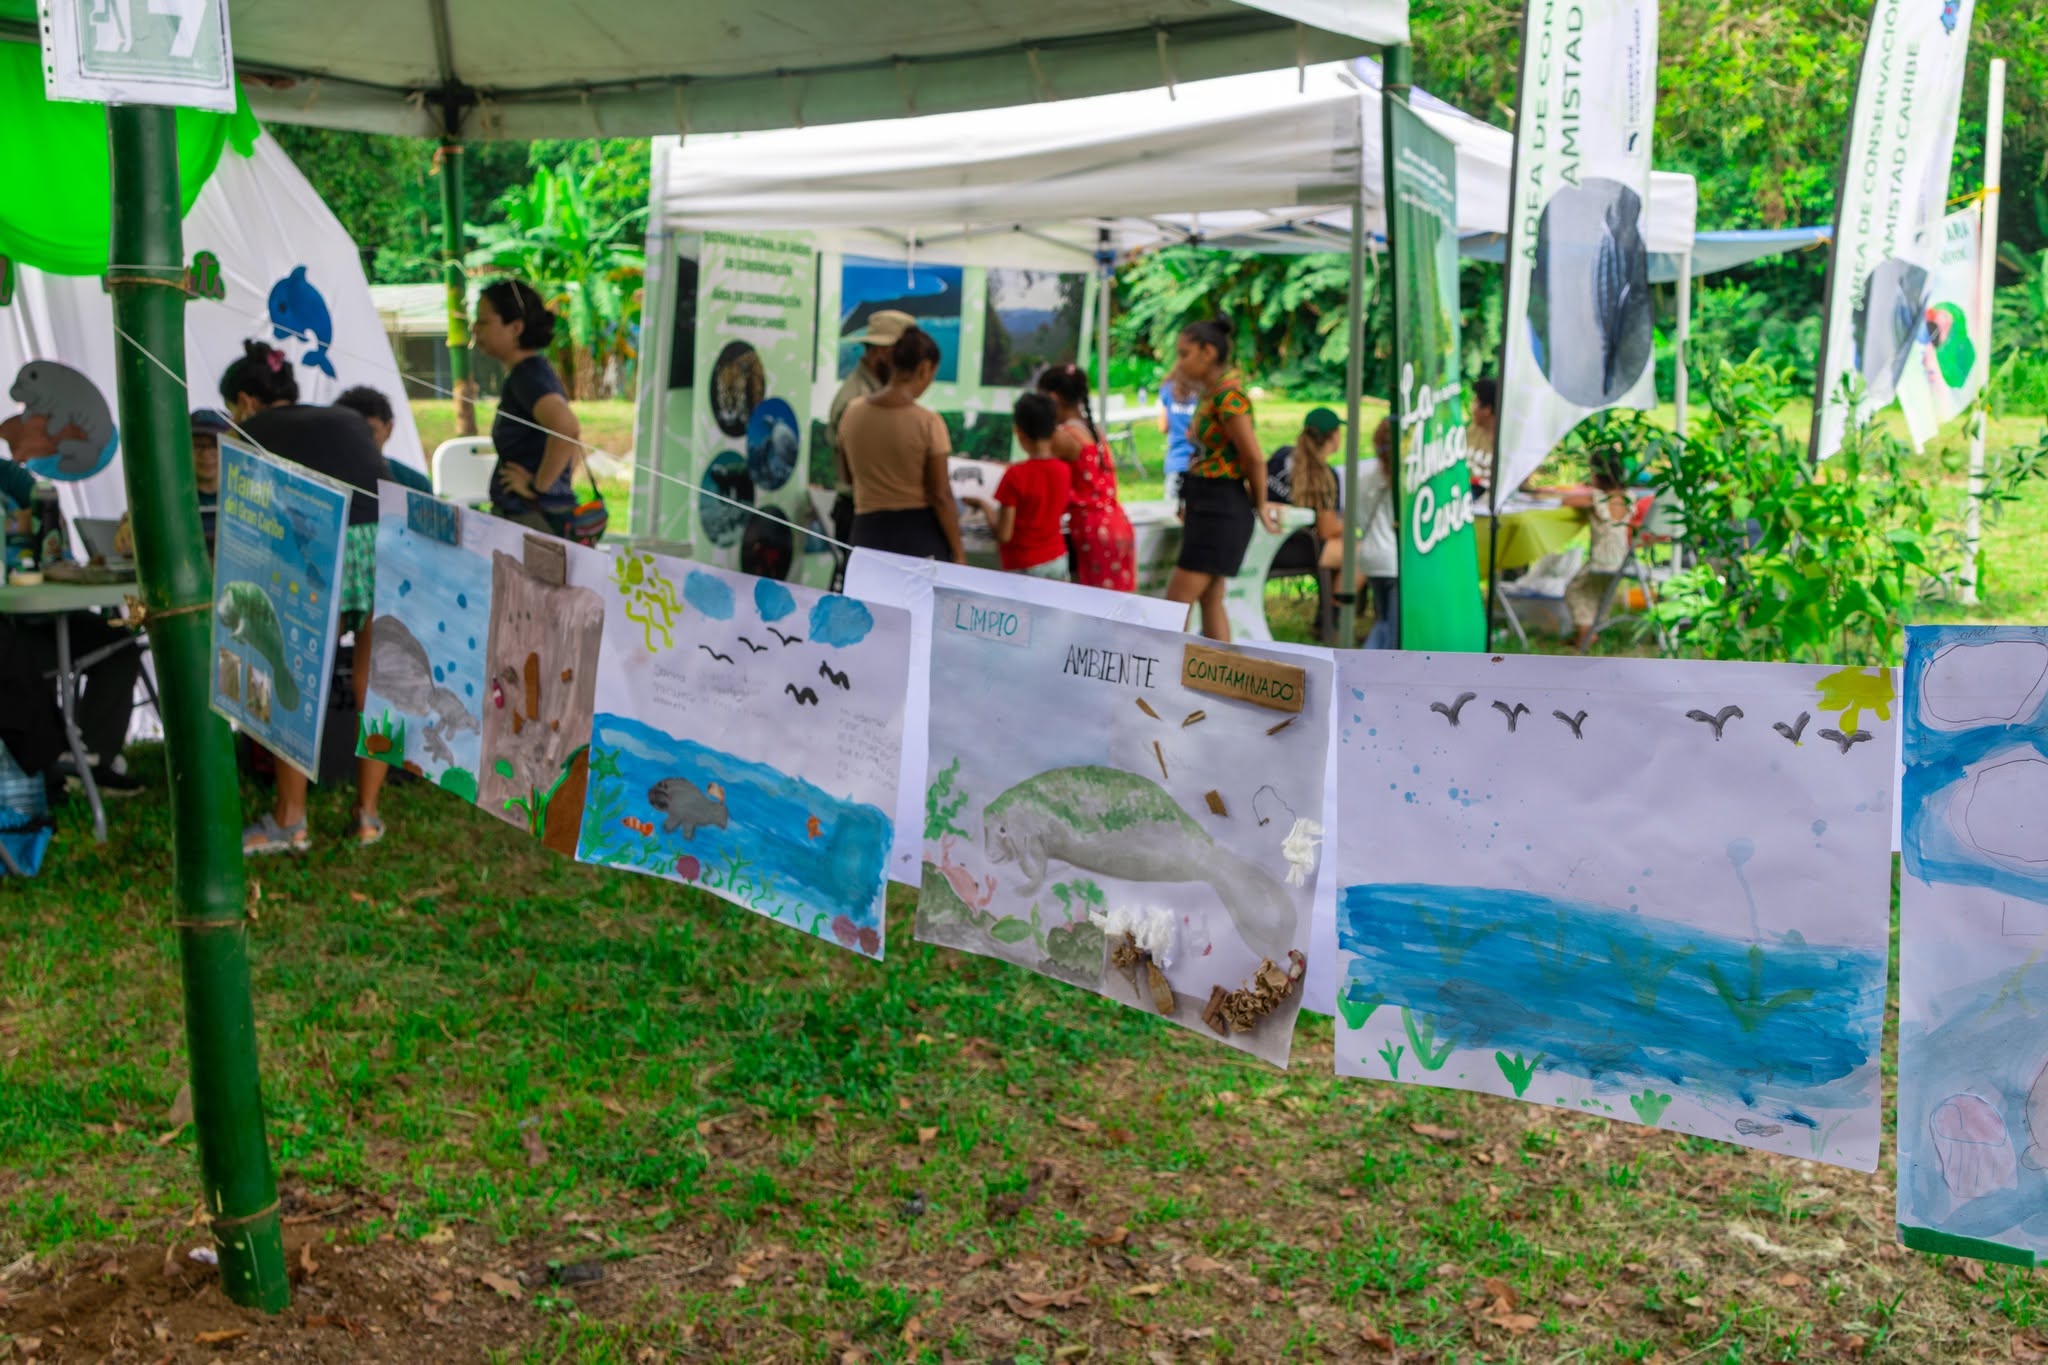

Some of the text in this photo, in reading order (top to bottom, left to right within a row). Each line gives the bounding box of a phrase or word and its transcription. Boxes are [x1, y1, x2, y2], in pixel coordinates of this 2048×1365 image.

[1560, 6, 1584, 187] AMISTAD
[1532, 99, 1550, 150] DE
[1882, 40, 1921, 263] AMISTAD CARIBE
[1858, 206, 1873, 236] DE
[1400, 361, 1435, 431] La
[224, 496, 238, 518] del
[238, 502, 257, 524] Gran
[258, 510, 285, 541] Caribe
[954, 602, 1018, 638] LIMPIO
[1063, 644, 1160, 689] AMBIENTE
[1187, 657, 1295, 702] CONTAMINADO
